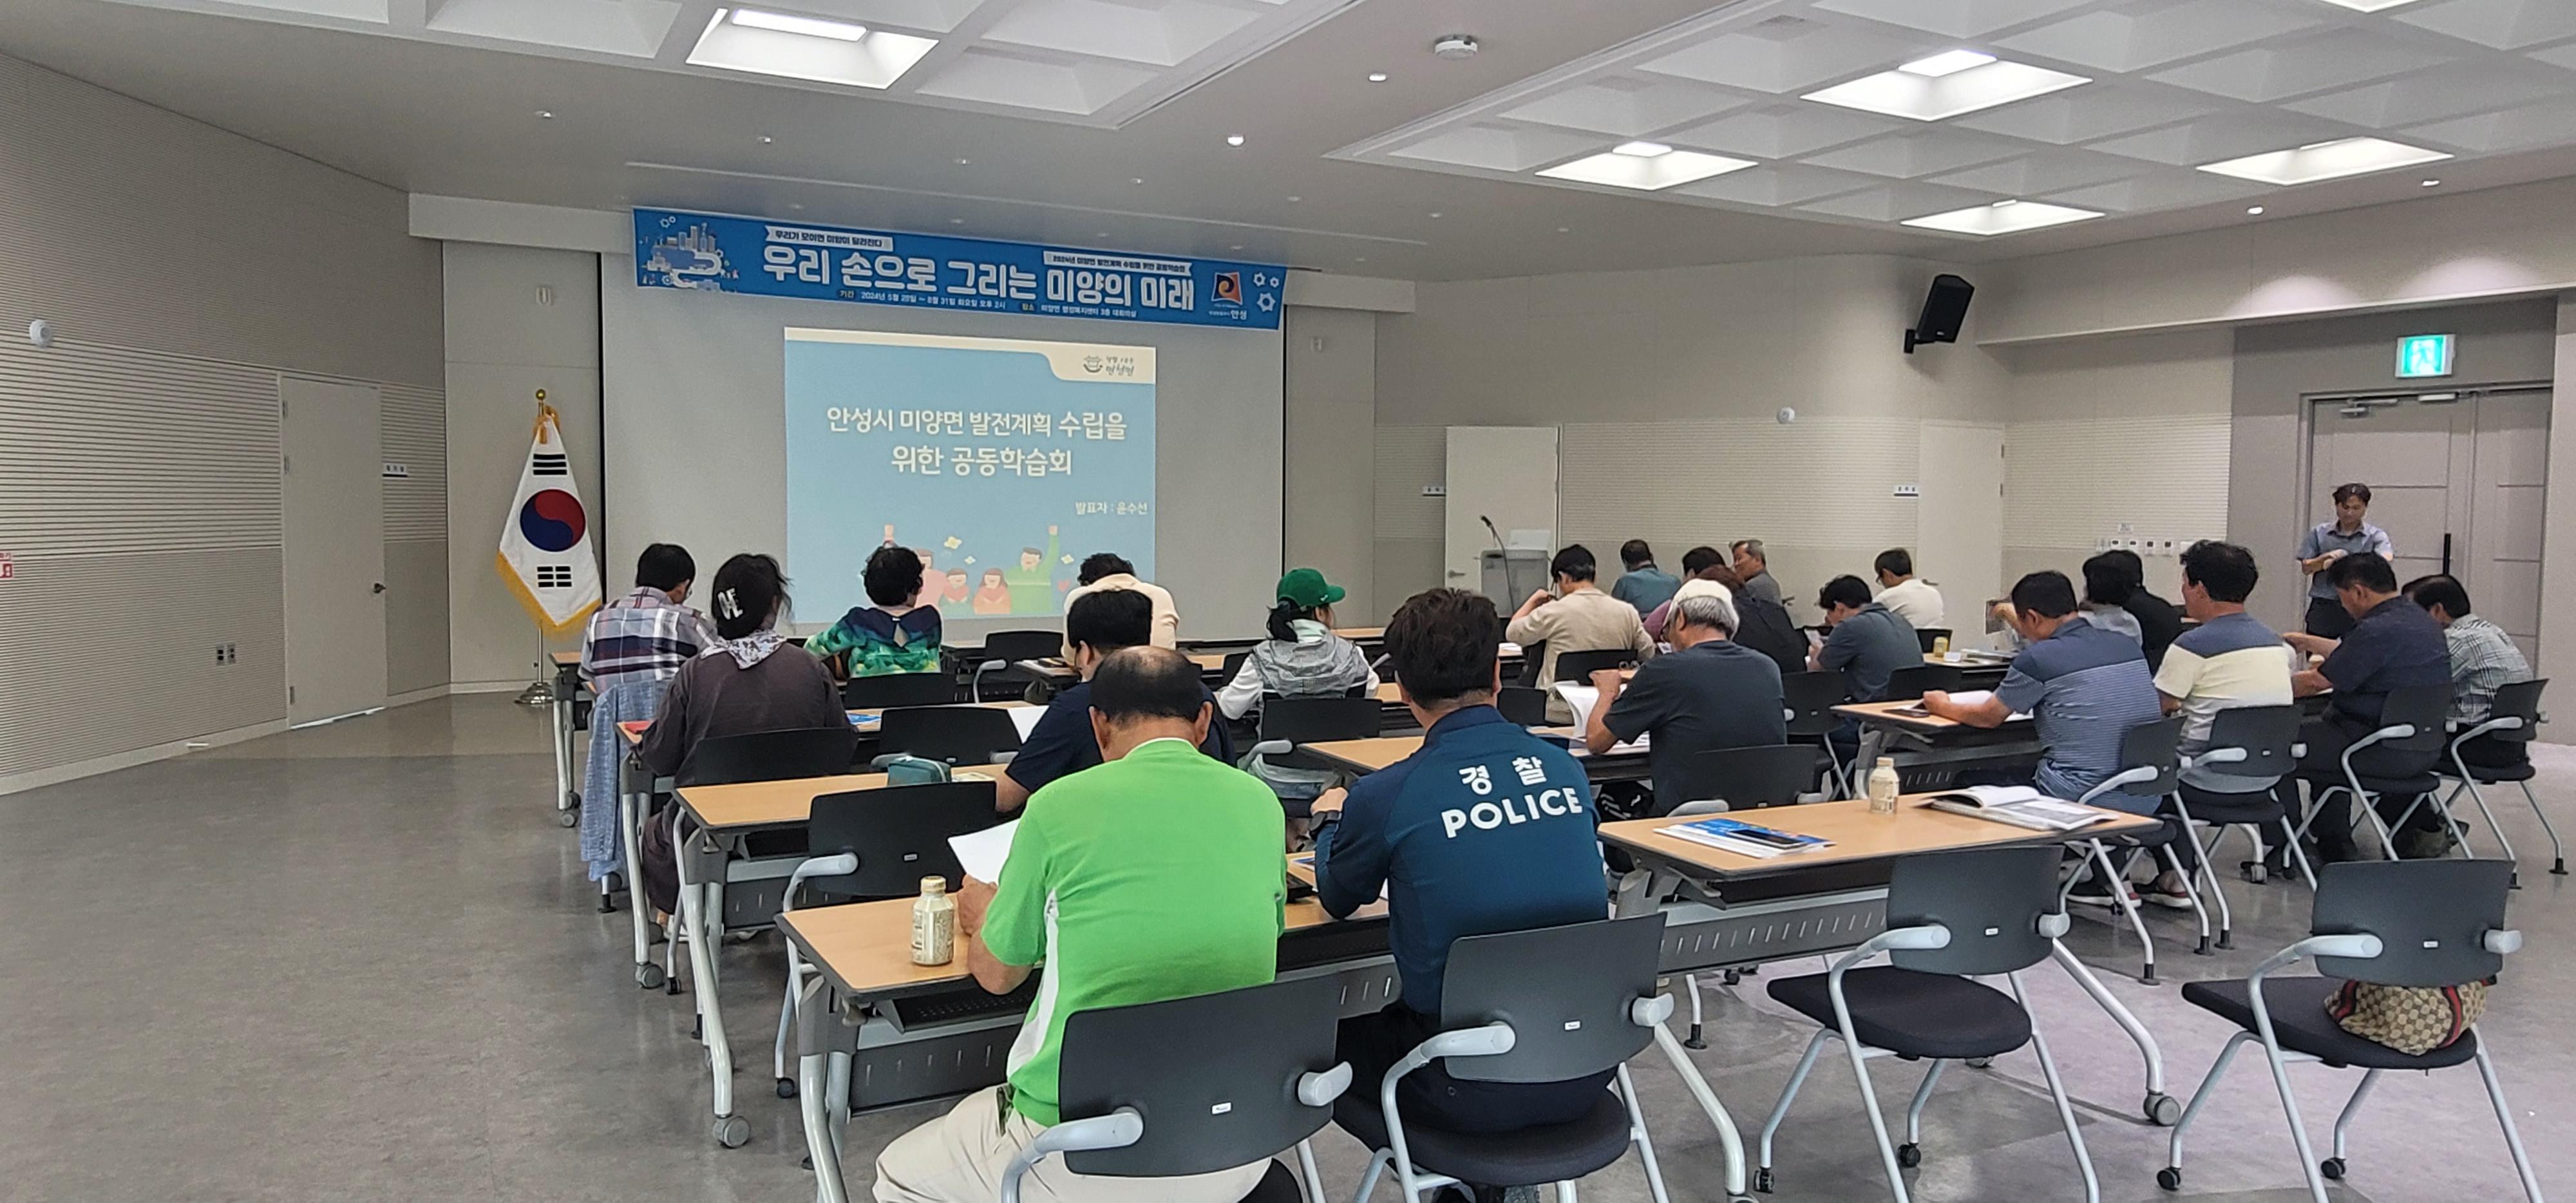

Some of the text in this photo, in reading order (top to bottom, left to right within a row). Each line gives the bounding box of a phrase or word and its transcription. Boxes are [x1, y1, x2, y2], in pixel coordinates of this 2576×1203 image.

[764, 245, 1194, 310] 우리 손으로 그리는 미양의 미래
[861, 291, 886, 301] 2024년
[826, 406, 1127, 440] 안성시 미양면 발전계획 수립을
[892, 445, 1072, 477] 위한 공동학습회
[1075, 501, 1107, 515] 발표자
[1441, 787, 1583, 838] POLICE
